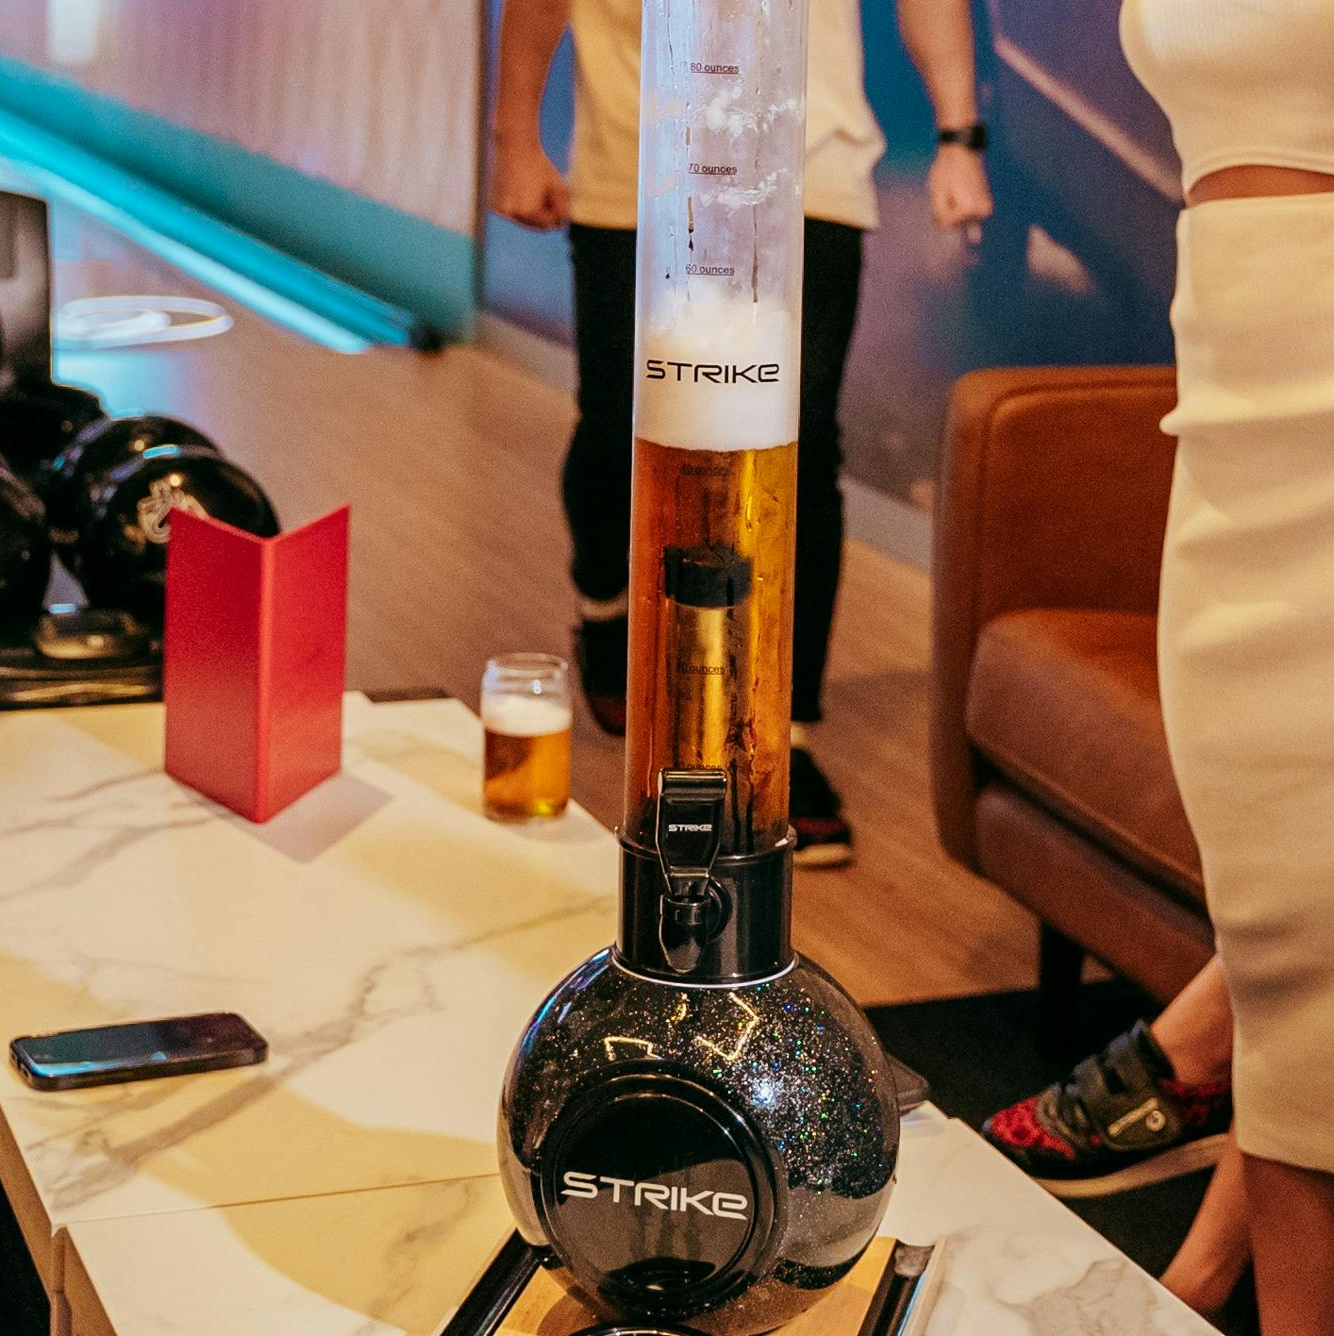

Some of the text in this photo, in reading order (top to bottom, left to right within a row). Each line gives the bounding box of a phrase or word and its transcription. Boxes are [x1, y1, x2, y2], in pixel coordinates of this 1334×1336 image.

[690, 62, 739, 74] 80 ounces
[688, 163, 738, 175] 70 ounces
[685, 263, 735, 276] 60 ounces
[645, 359, 780, 384] STRIKE
[668, 824, 713, 832] STRIKE
[560, 1171, 749, 1221] STRIKE
